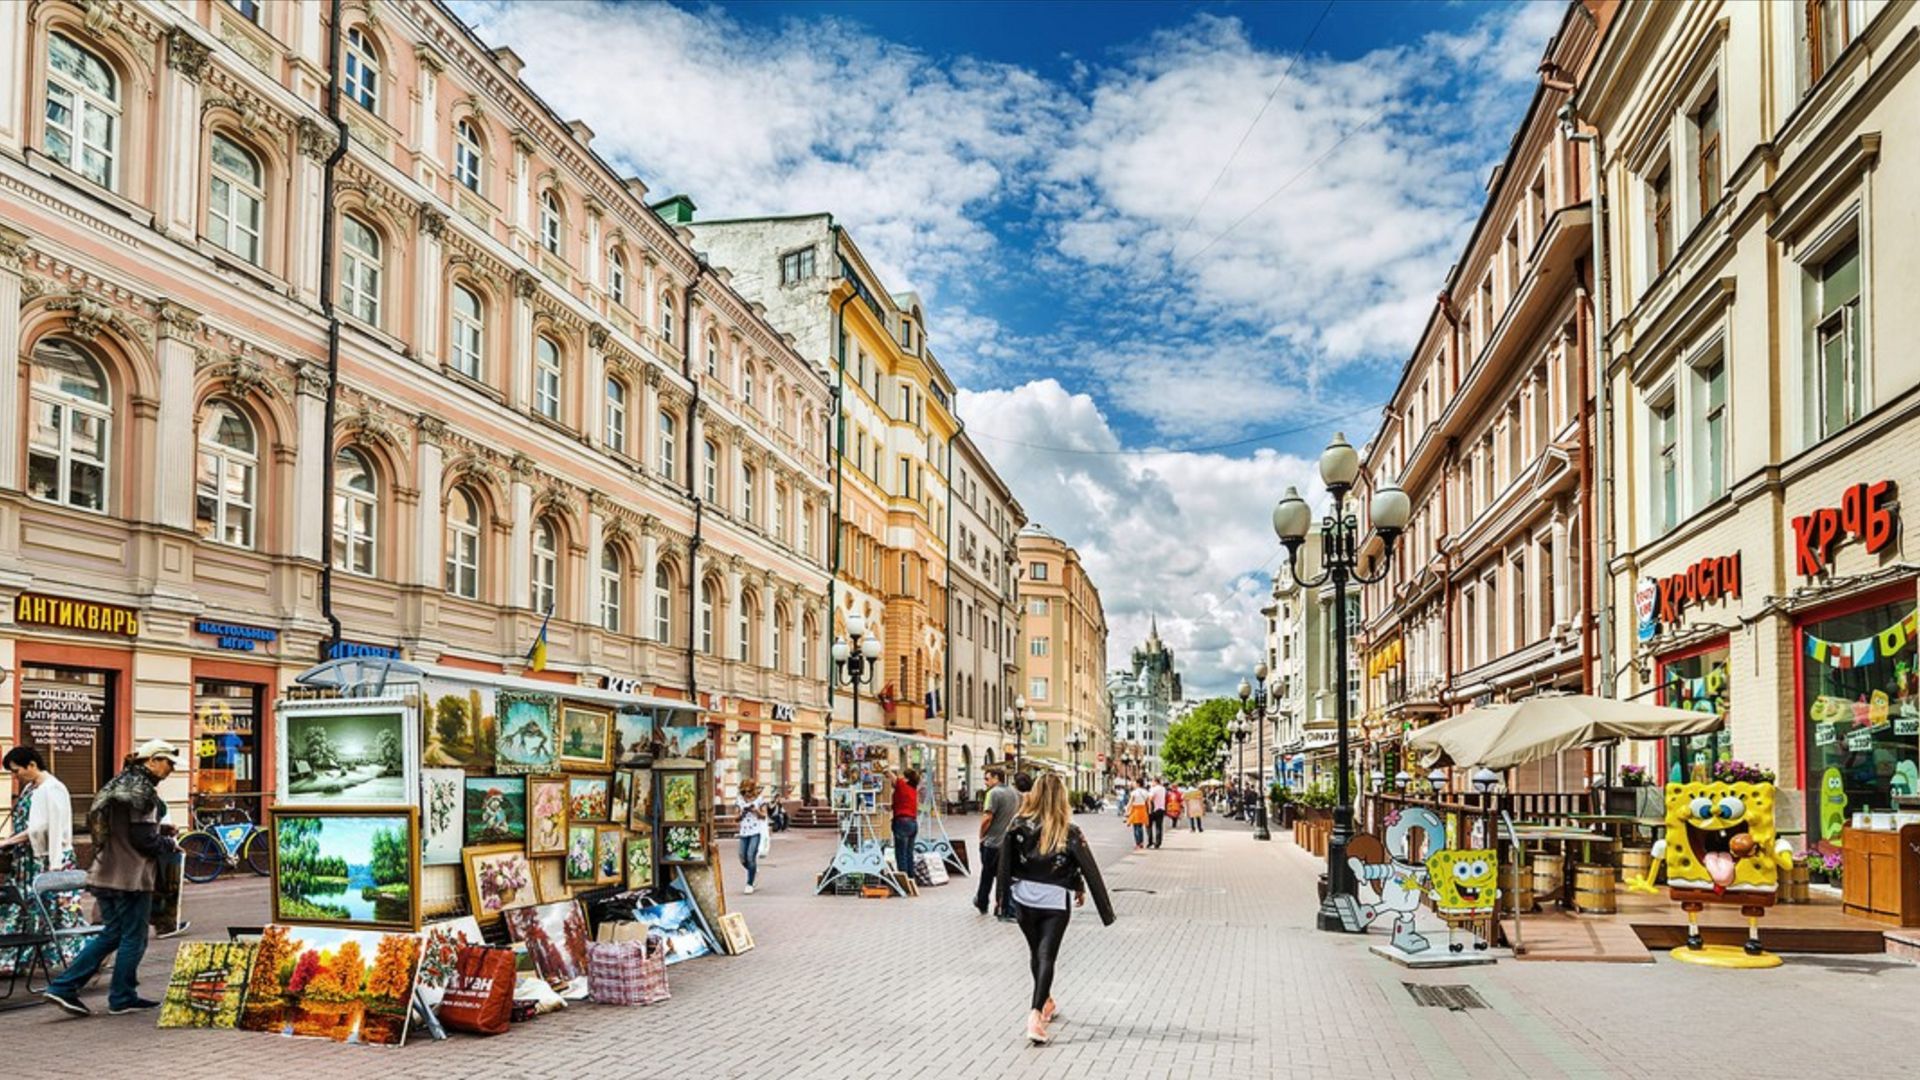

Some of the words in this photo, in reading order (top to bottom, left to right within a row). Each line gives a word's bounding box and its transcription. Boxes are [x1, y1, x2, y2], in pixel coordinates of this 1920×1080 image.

[18, 595, 138, 635] АНТИКВАРЪ
[199, 622, 277, 641] НАСТОЛЬНЫЕ
[222, 636, 255, 650] ИГРЫ
[608, 676, 642, 694] KFC
[34, 700, 93, 712] ПОКУПКА
[776, 703, 797, 721] KFC
[25, 711, 101, 722] АНТИКВАРИАТ
